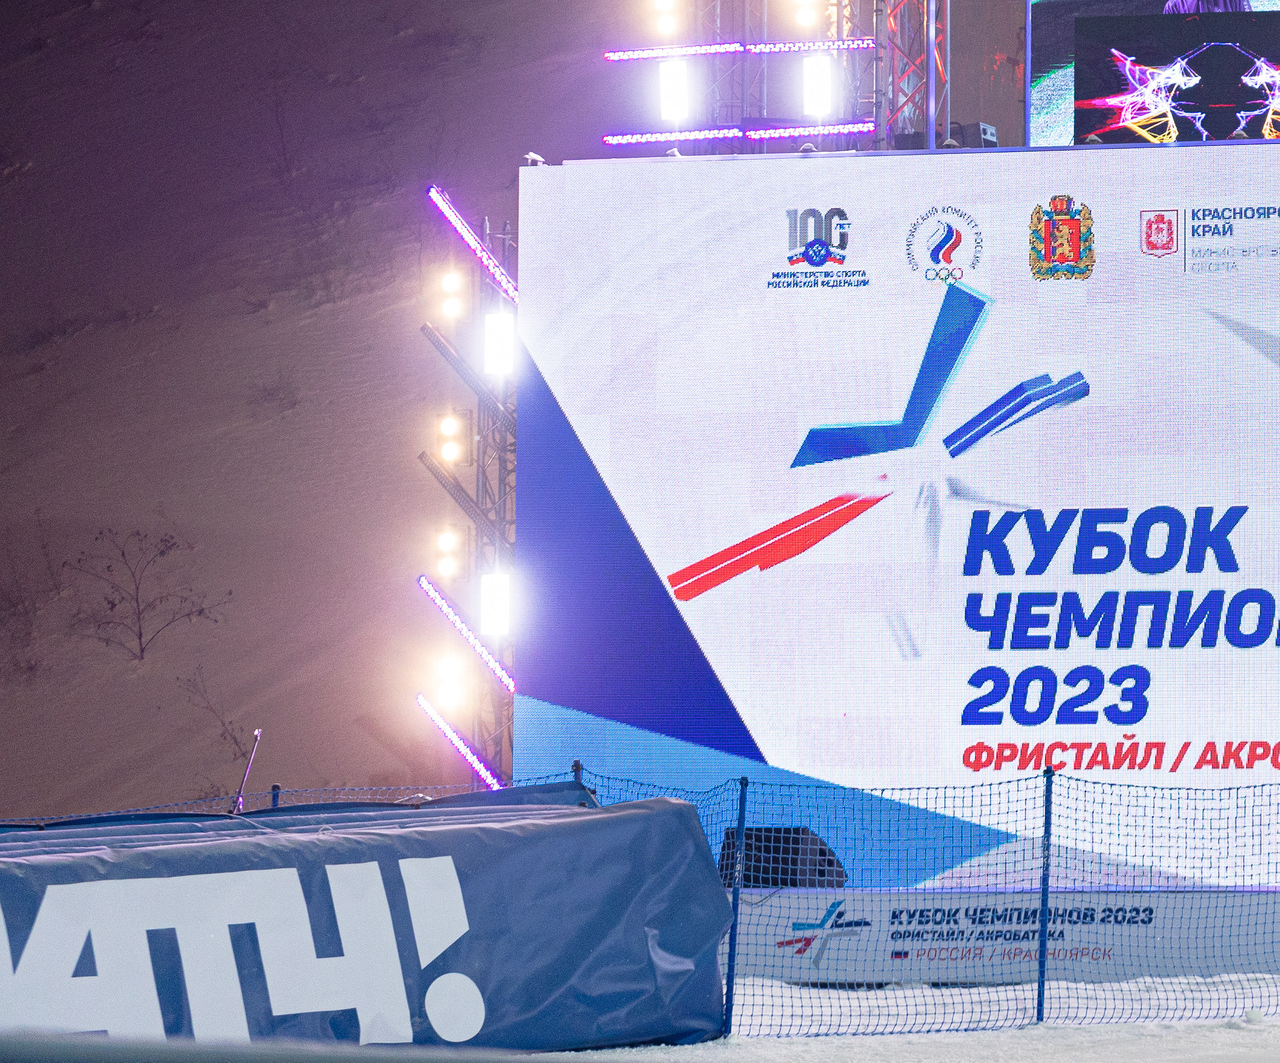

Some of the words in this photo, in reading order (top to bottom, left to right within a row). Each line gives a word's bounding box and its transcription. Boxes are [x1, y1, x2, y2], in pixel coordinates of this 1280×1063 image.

[786, 208, 848, 251] 100
[1191, 220, 1234, 237] КРАЙ
[962, 504, 1250, 577] КУБОК
[961, 664, 1151, 727] 2023
[962, 734, 1166, 772] ФРИСТАЙЛ
[890, 907, 960, 926] КУБОК
[964, 906, 1097, 926] ЧЕМПИОНОВ
[1099, 906, 1154, 925] 2023
[0, 855, 487, 1047] АТЧ!
[916, 947, 983, 962] РОССИЯ
[1002, 946, 1114, 961] КРАСНОЯРСК
[975, 929, 1066, 942] АКРОБАТКА
